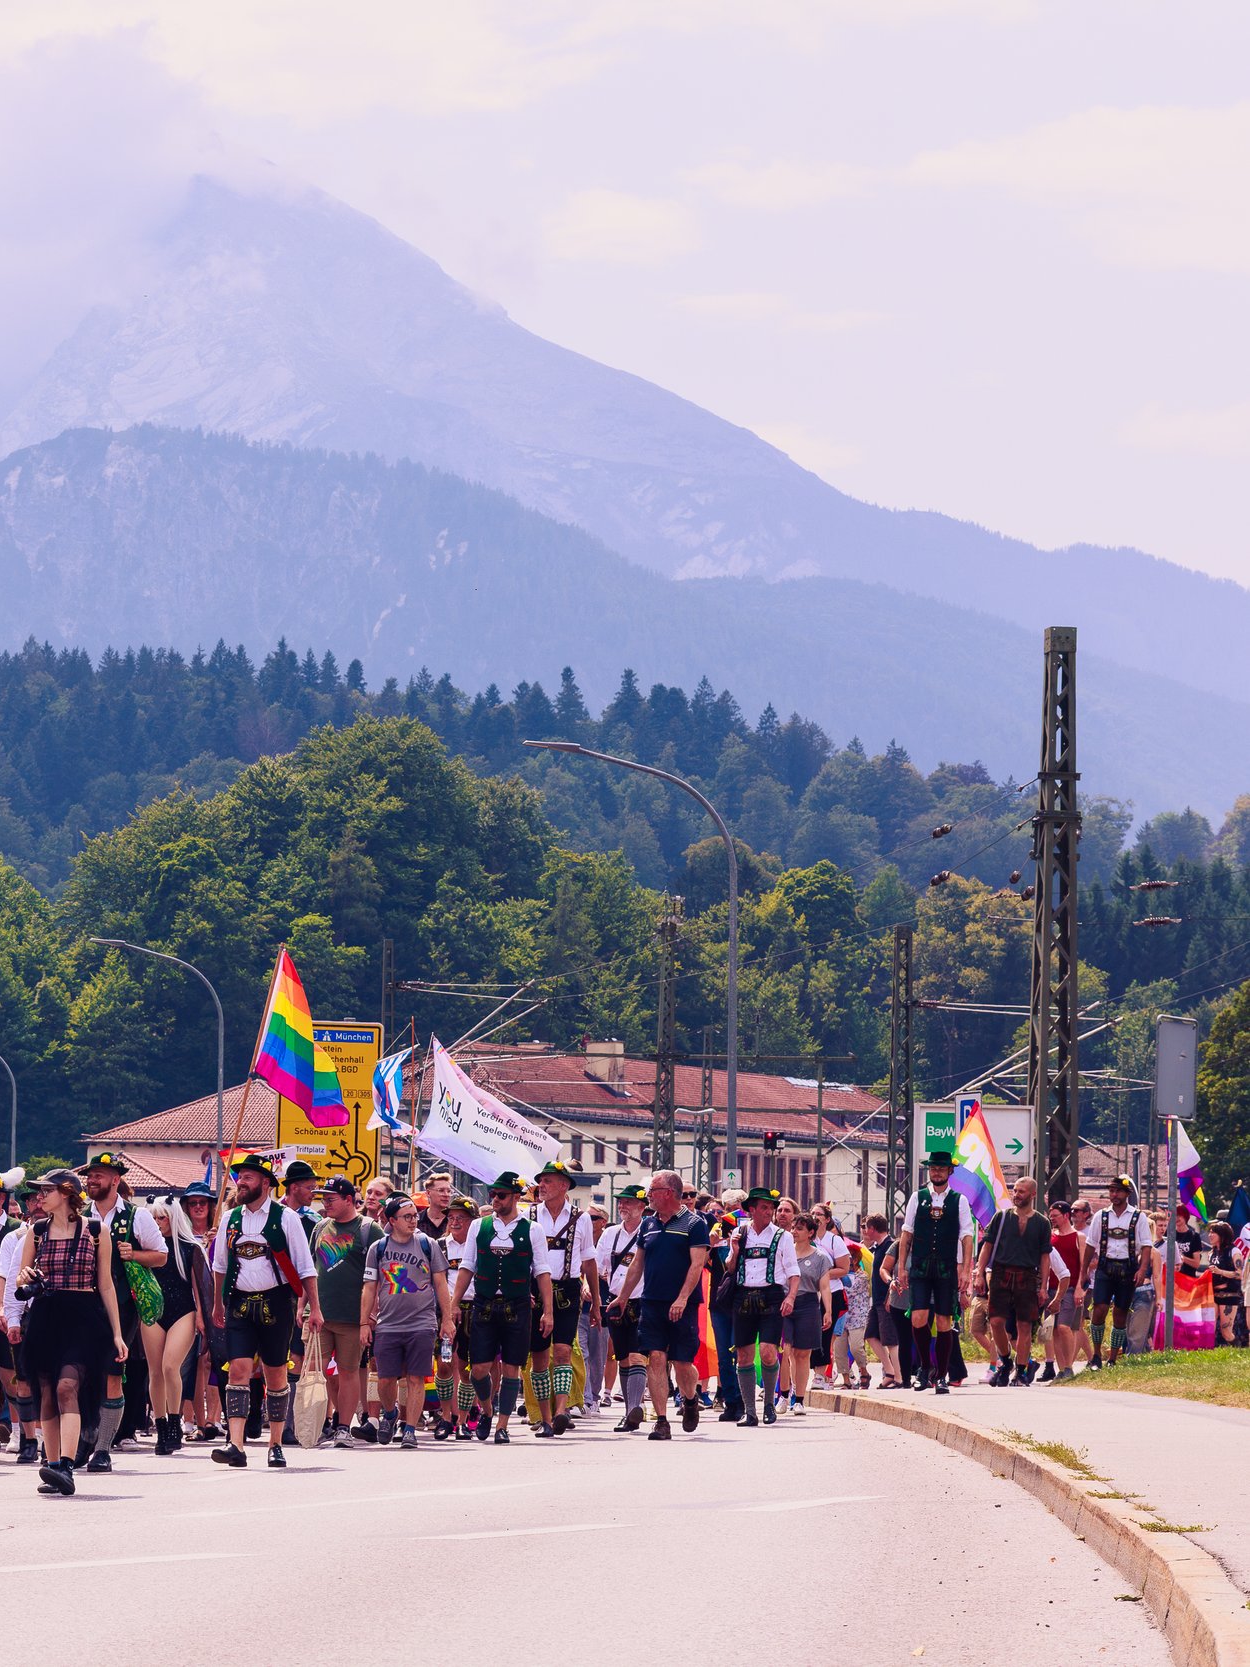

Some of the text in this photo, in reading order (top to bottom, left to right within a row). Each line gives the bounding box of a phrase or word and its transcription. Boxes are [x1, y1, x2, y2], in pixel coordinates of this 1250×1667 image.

[335, 1032, 372, 1041] München
[322, 1045, 342, 1053] stein
[476, 1106, 548, 1141] Verein für queere
[294, 1127, 347, 1137] Schönau a.K.
[472, 1120, 543, 1152] Angelegenheiten
[926, 1125, 956, 1138] BayW
[296, 1145, 325, 1154] Triftplatz
[385, 1251, 425, 1269] URRIDE
